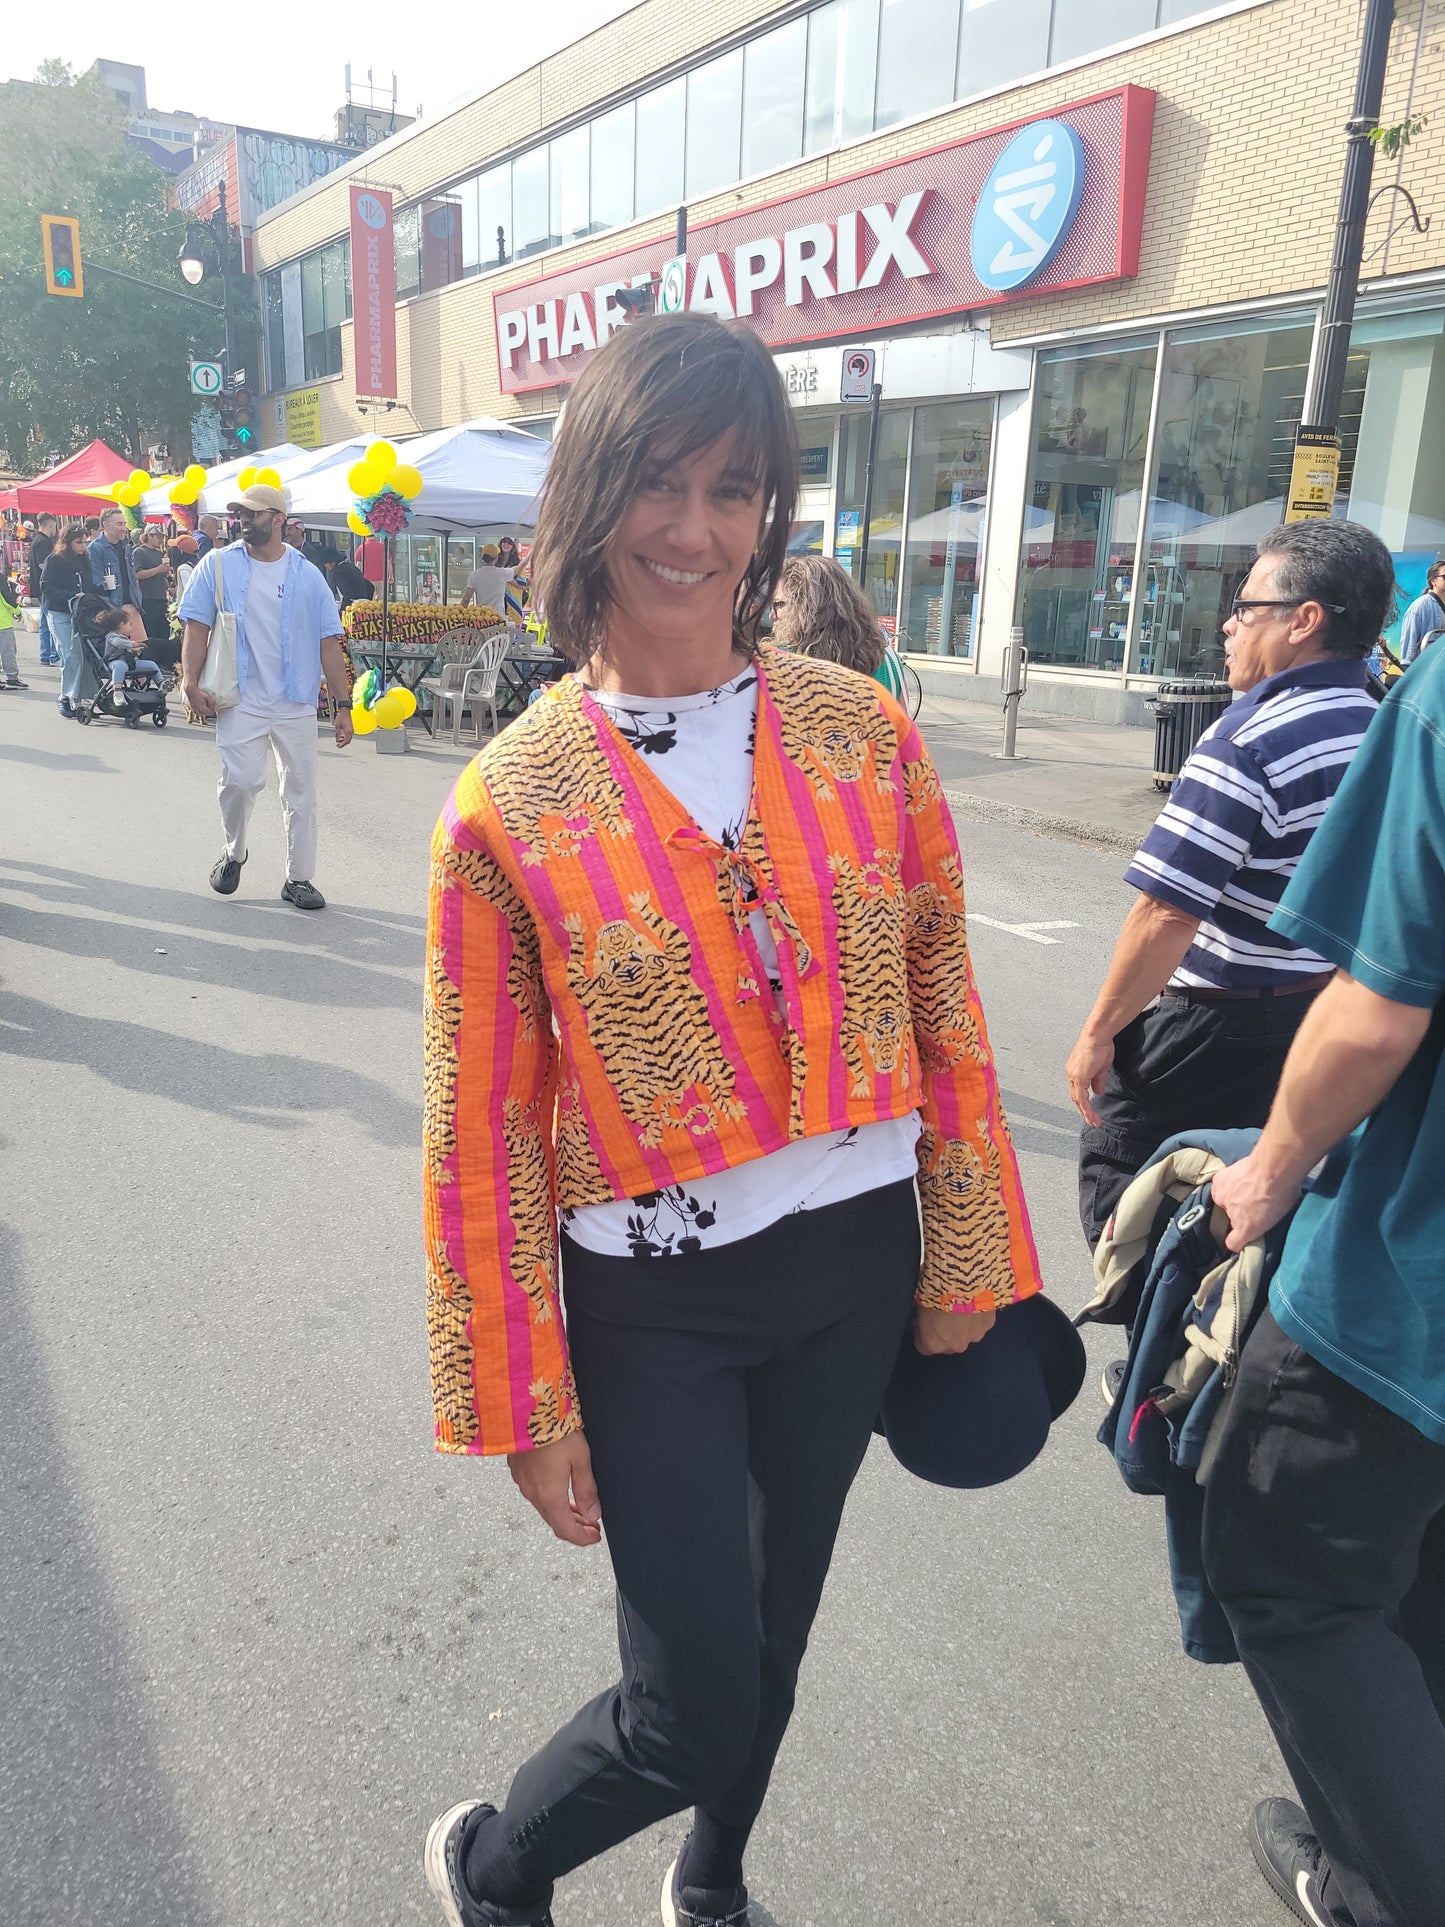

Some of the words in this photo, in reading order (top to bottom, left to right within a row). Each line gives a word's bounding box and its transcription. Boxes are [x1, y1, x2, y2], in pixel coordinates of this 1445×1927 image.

[499, 189, 933, 368] PHARAPRIX
[367, 235, 383, 389] PHARMAPRIX
[785, 364, 819, 393] ÈRE
[402, 620, 432, 639] TAST
[431, 619, 457, 634] ASTE
